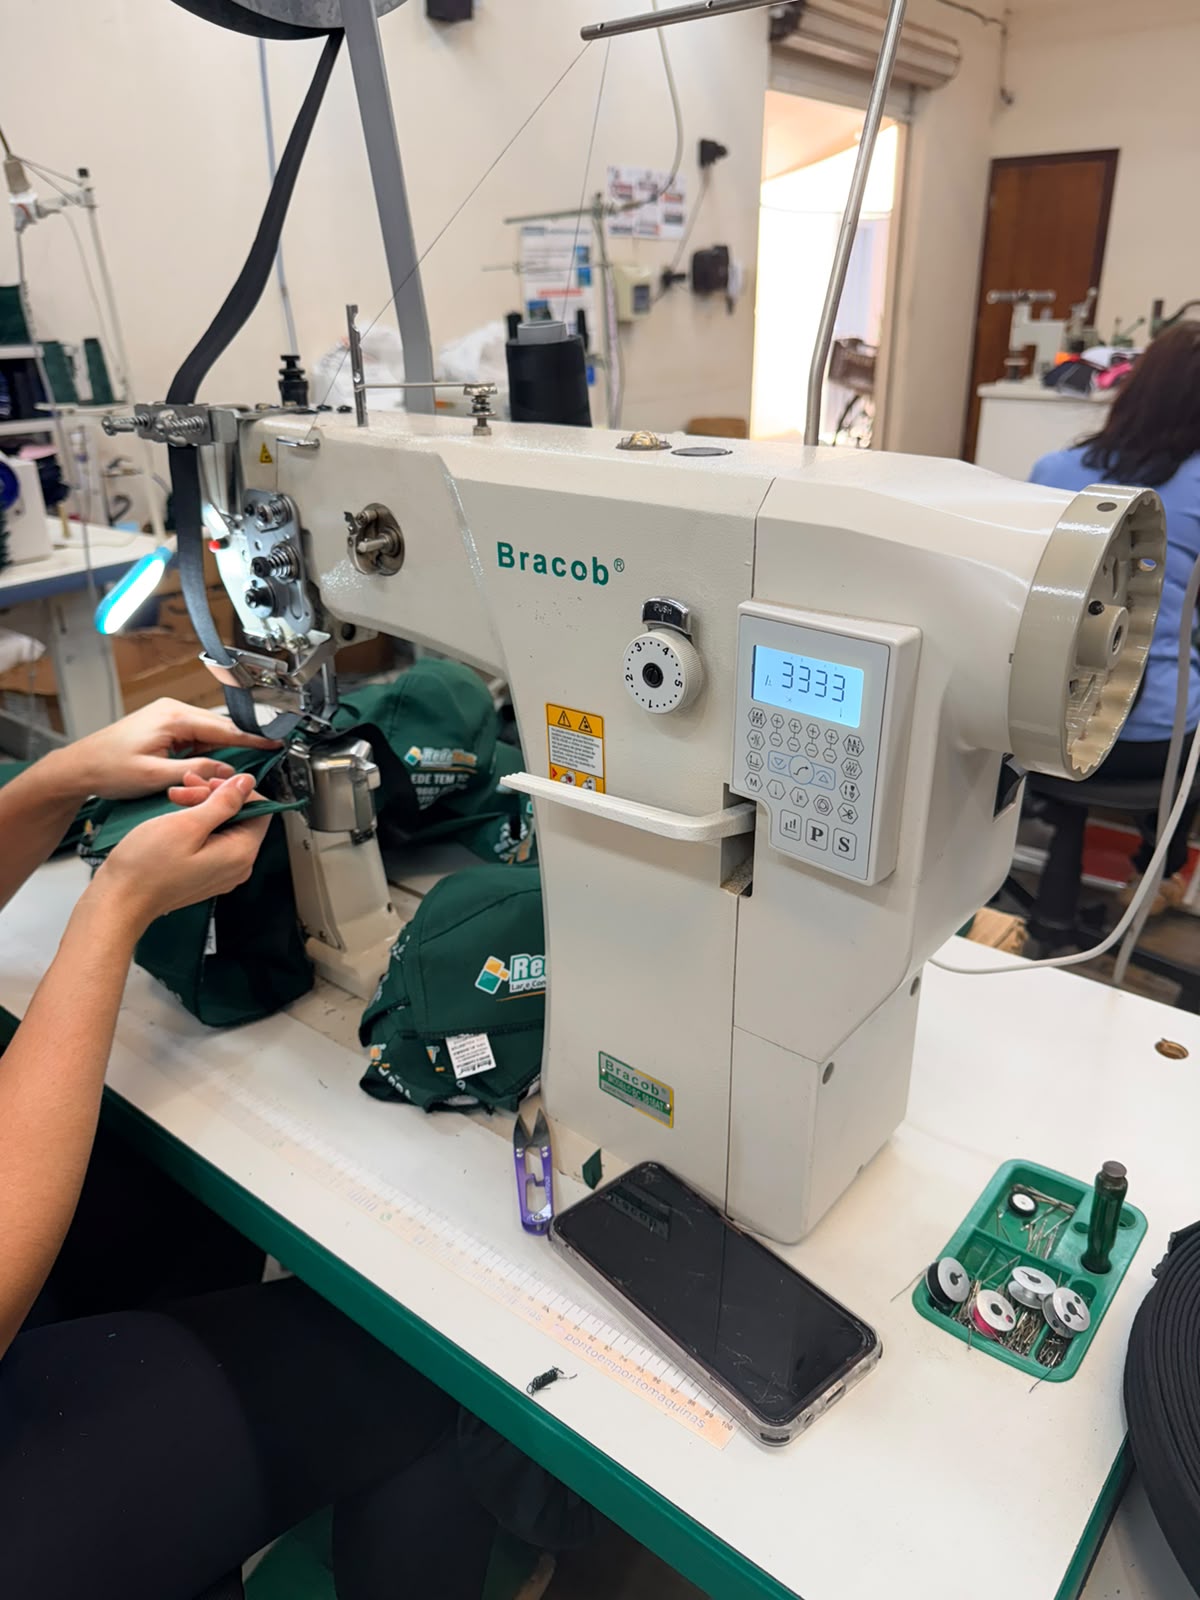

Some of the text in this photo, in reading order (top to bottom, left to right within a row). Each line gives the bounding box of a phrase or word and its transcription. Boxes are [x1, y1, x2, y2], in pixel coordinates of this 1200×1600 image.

[653, 603, 673, 615] PUSH
[634, 642, 643, 652] 3
[662, 647, 670, 656] 4
[625, 673, 634, 682] 2
[781, 661, 846, 702] 3333
[674, 679, 683, 688] 5
[810, 826, 824, 842] P
[838, 836, 850, 853] S
[511, 983, 524, 991] Lar
